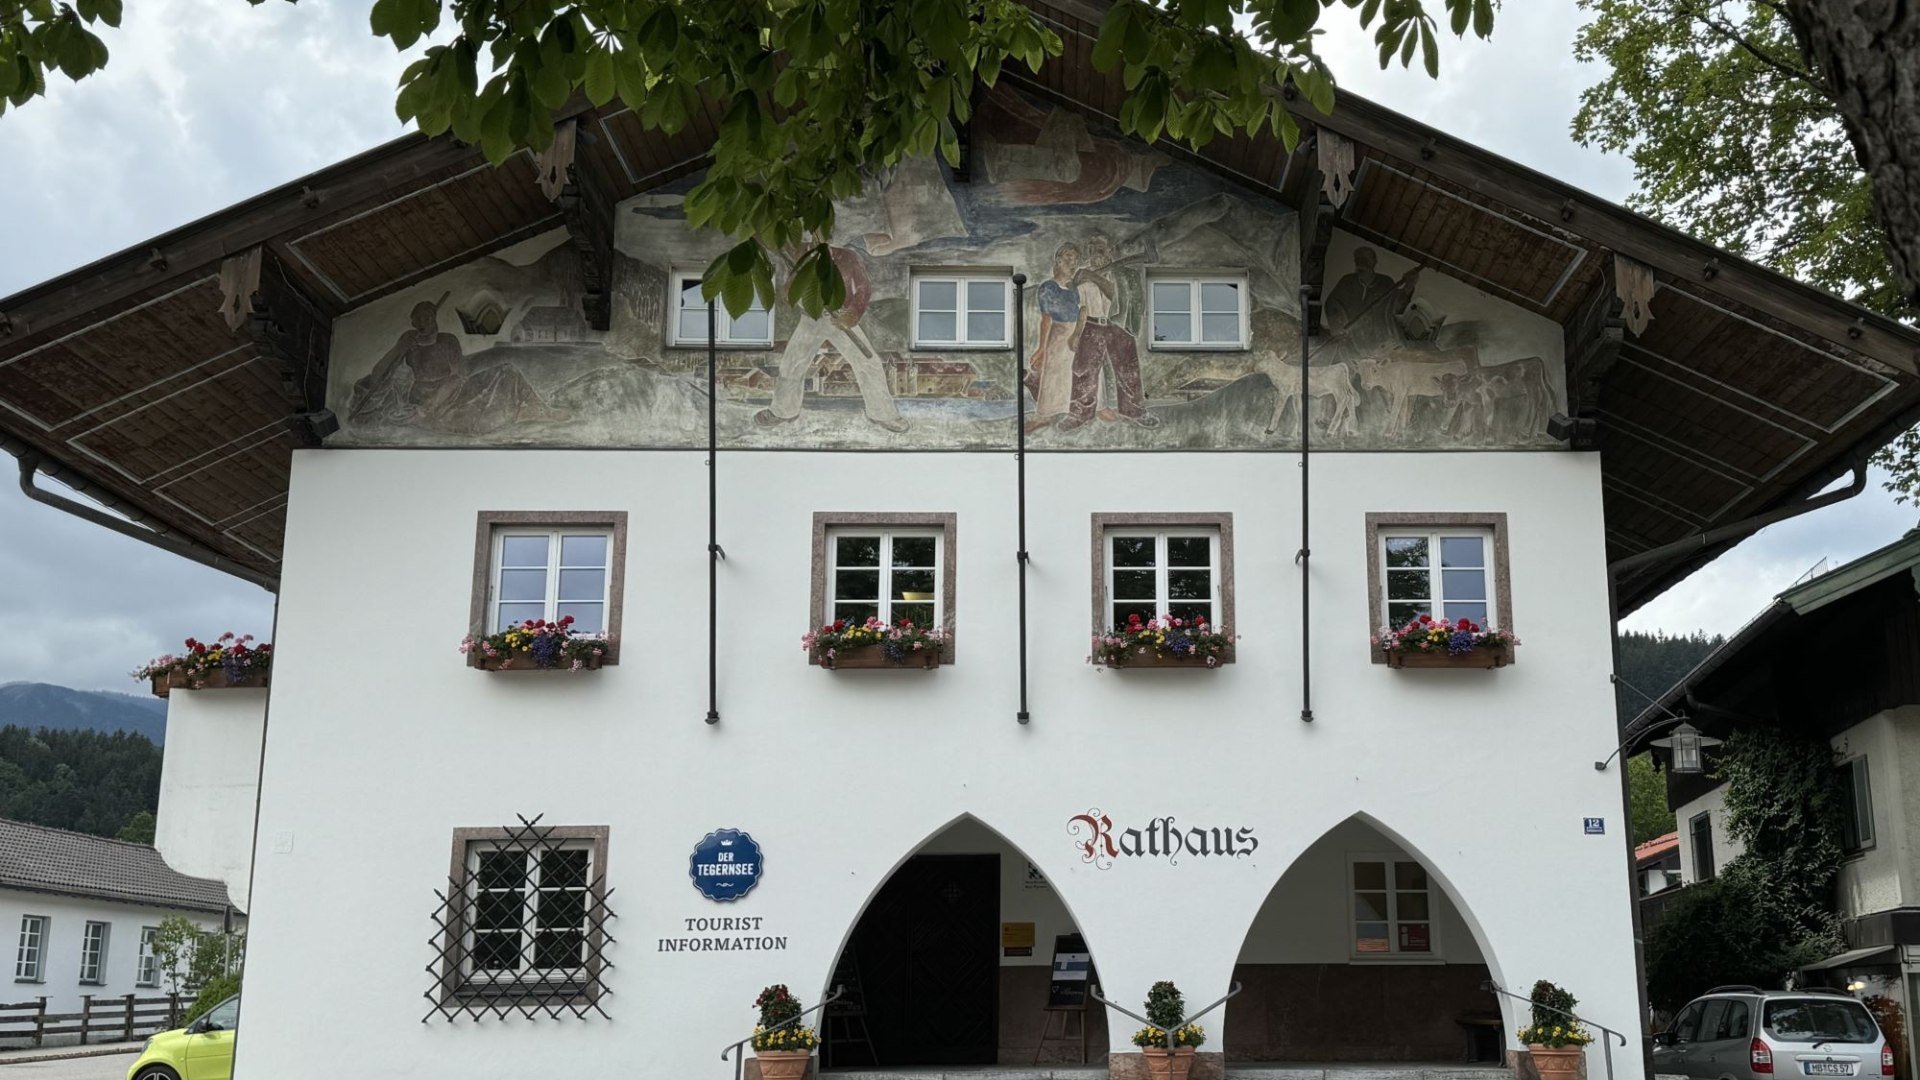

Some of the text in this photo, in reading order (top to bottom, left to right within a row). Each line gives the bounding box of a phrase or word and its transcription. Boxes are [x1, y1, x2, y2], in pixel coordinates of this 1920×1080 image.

[1588, 819, 1600, 828] 12
[1066, 807, 1259, 870] Rathaus
[718, 852, 734, 862] DER
[697, 863, 754, 876] TEGERNSEE
[685, 917, 763, 931] TOURIST
[657, 937, 788, 952] INFORMATION
